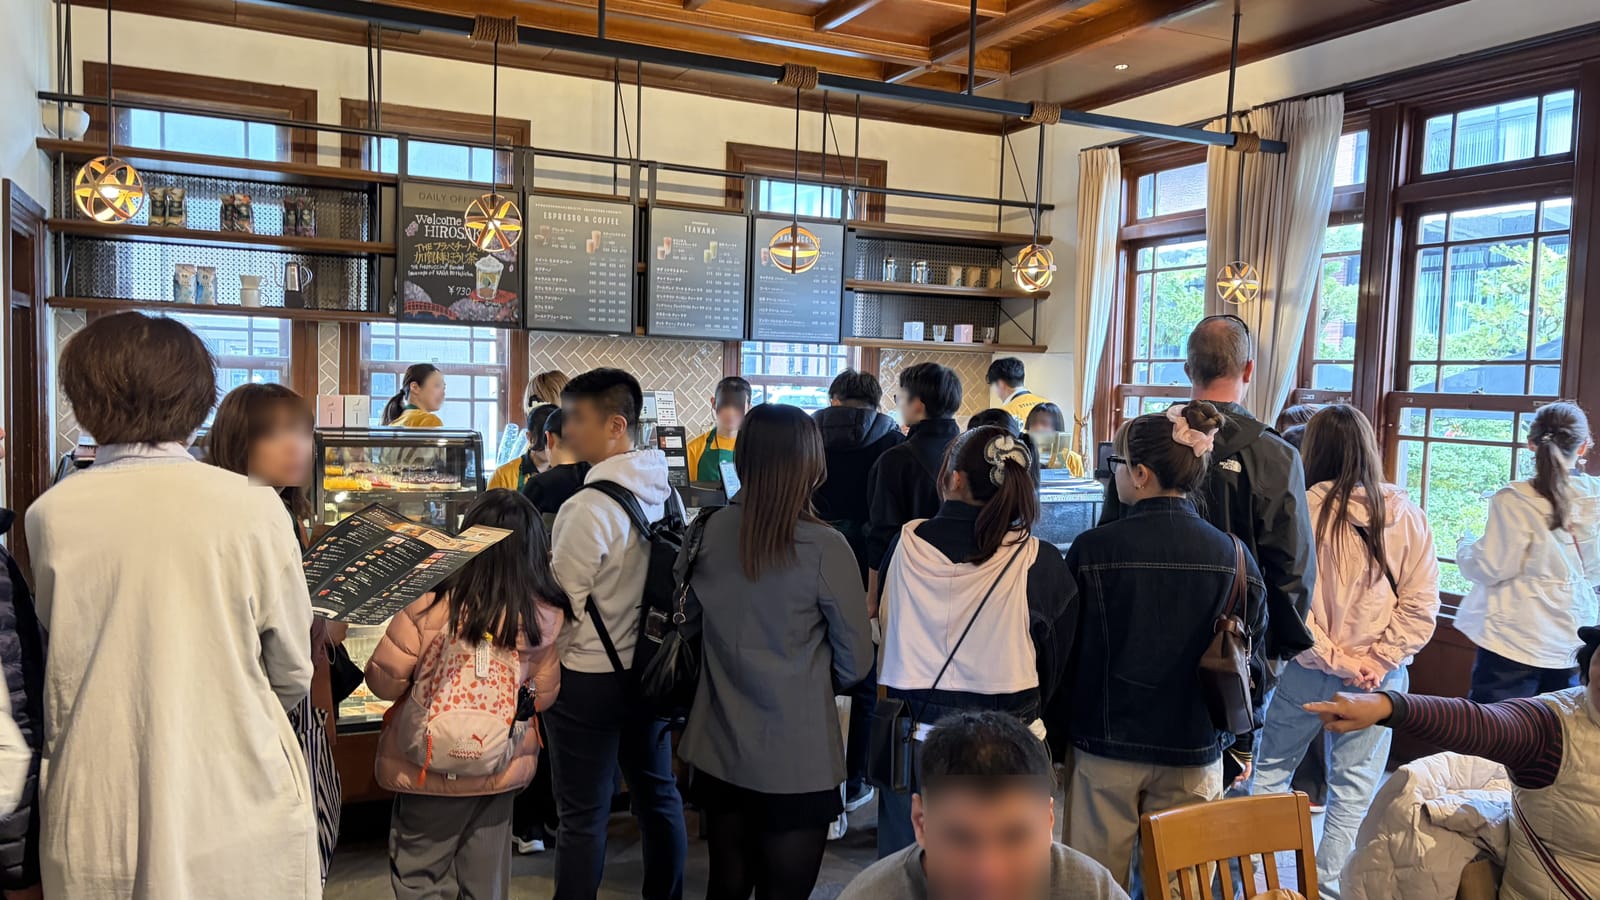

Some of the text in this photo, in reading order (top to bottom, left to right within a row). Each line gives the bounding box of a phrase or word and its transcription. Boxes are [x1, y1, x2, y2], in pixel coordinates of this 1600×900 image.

[418, 191, 447, 202] DAILY
[415, 212, 462, 226] Welcome
[543, 211, 619, 226] ESPRESSO & COFFEE
[424, 225, 483, 241] HIROSAK
[684, 225, 716, 235] TEAVANA
[414, 242, 433, 253] THE
[447, 285, 472, 298] ¥730
